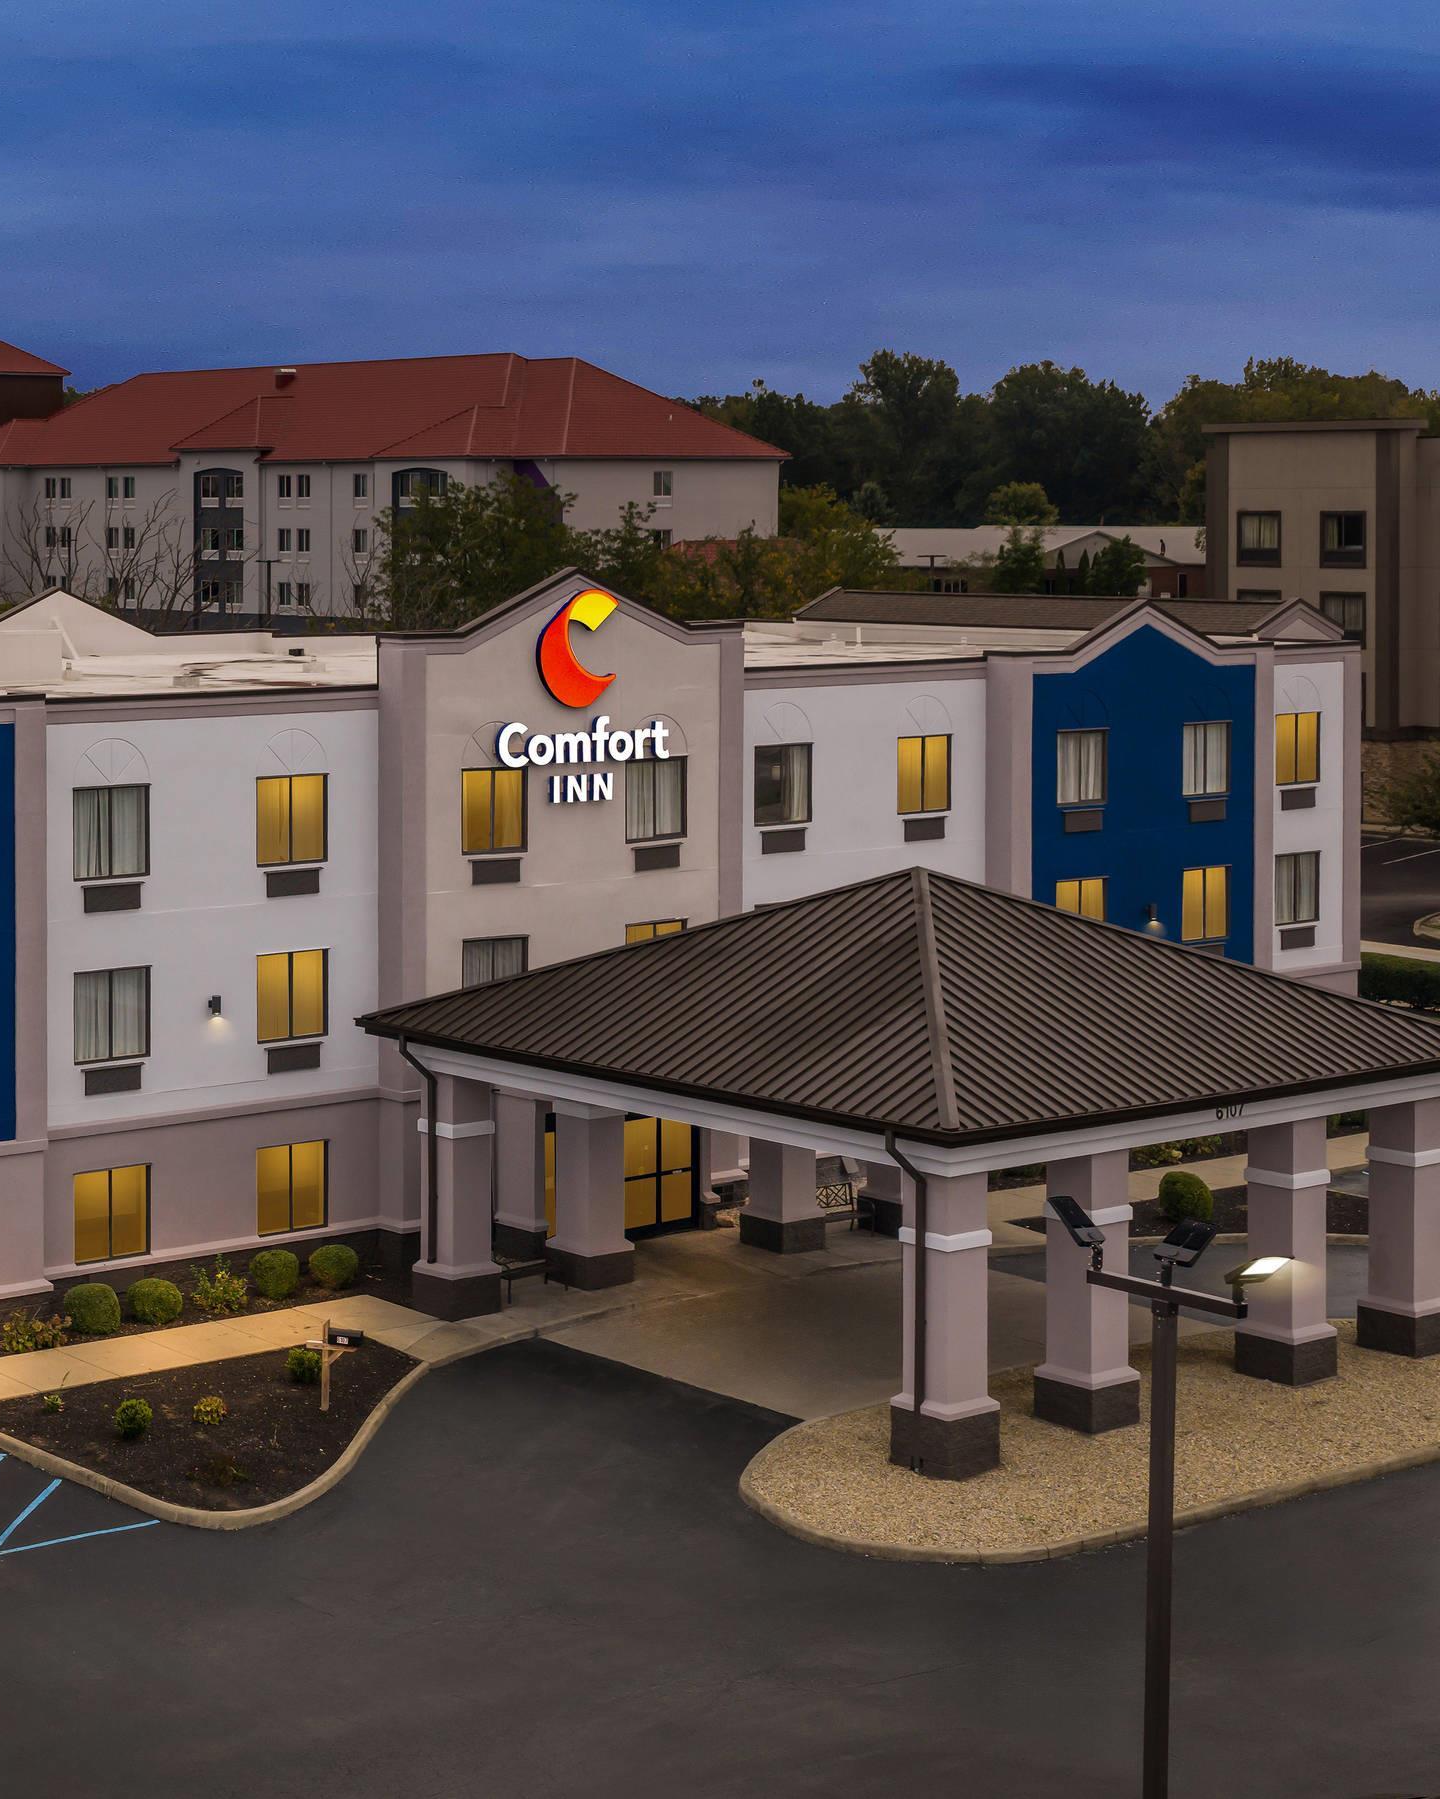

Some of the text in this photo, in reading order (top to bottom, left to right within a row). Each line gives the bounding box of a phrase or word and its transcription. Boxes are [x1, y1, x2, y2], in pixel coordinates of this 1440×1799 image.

[496, 715, 670, 768] Comfort
[550, 773, 614, 804] INN
[1215, 1104, 1245, 1121] 6107
